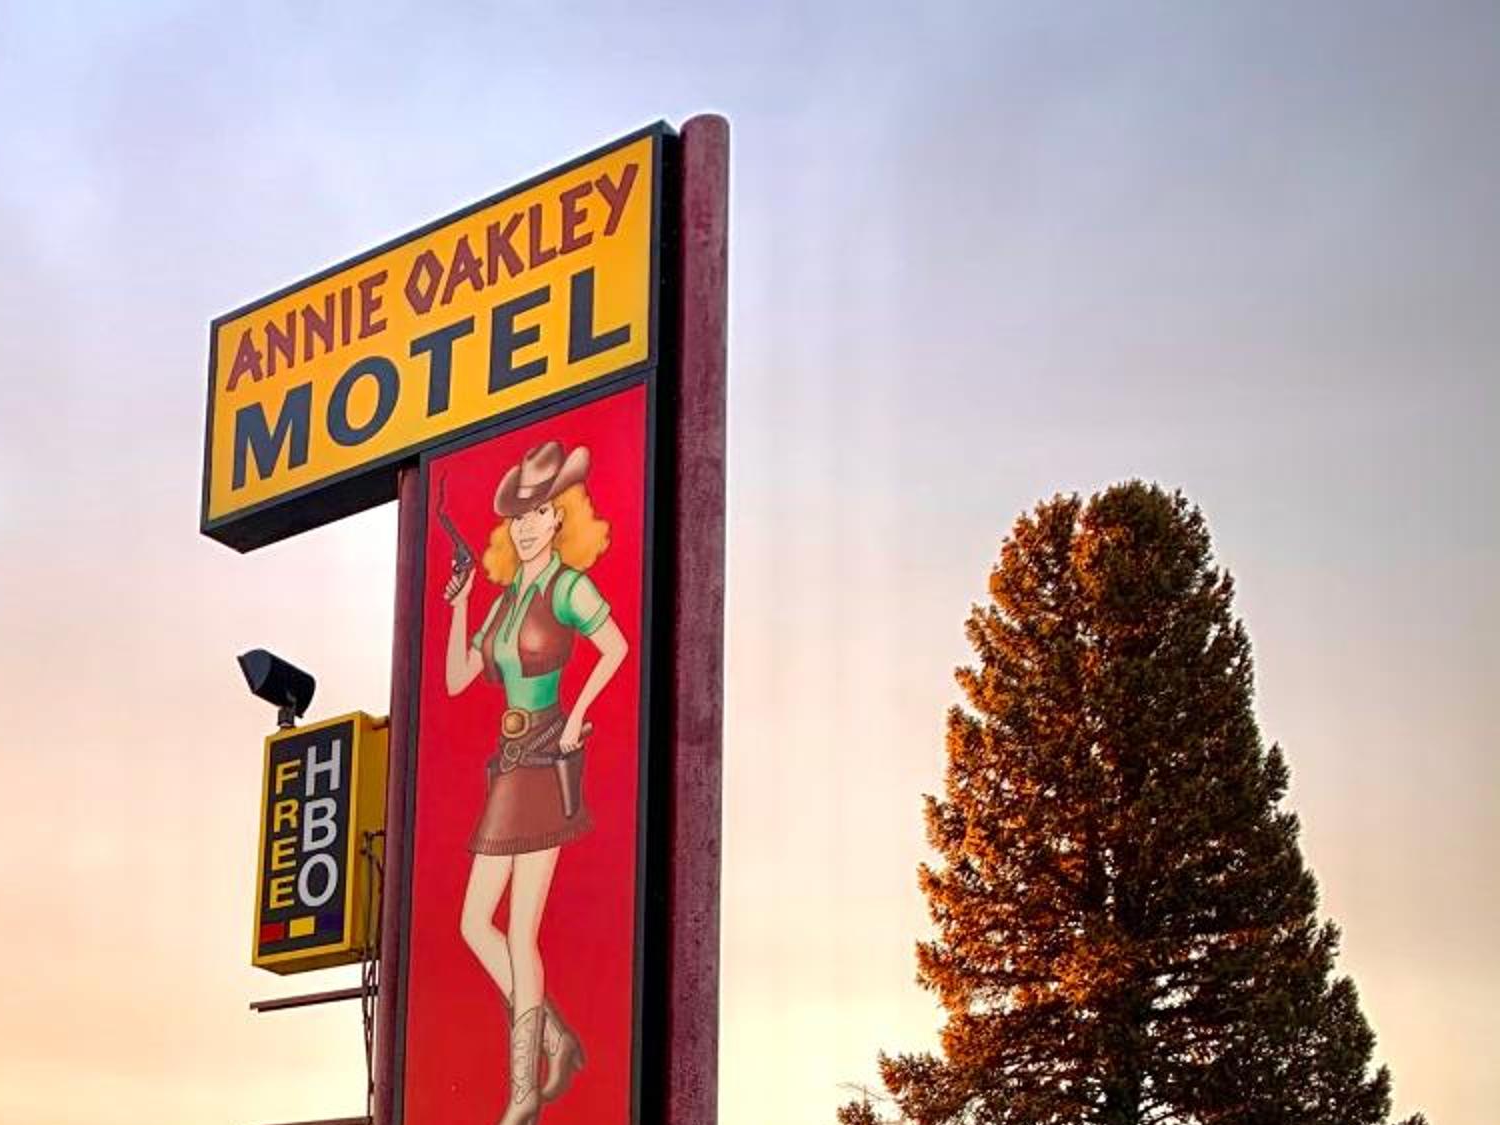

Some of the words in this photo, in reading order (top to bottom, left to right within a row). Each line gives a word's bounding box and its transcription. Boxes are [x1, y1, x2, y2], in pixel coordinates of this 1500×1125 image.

[226, 270, 388, 391] ANNIE
[404, 163, 638, 315] OAKLEY
[231, 266, 631, 491] MOTEL
[269, 759, 302, 909] FREE
[297, 739, 341, 907] HBO
